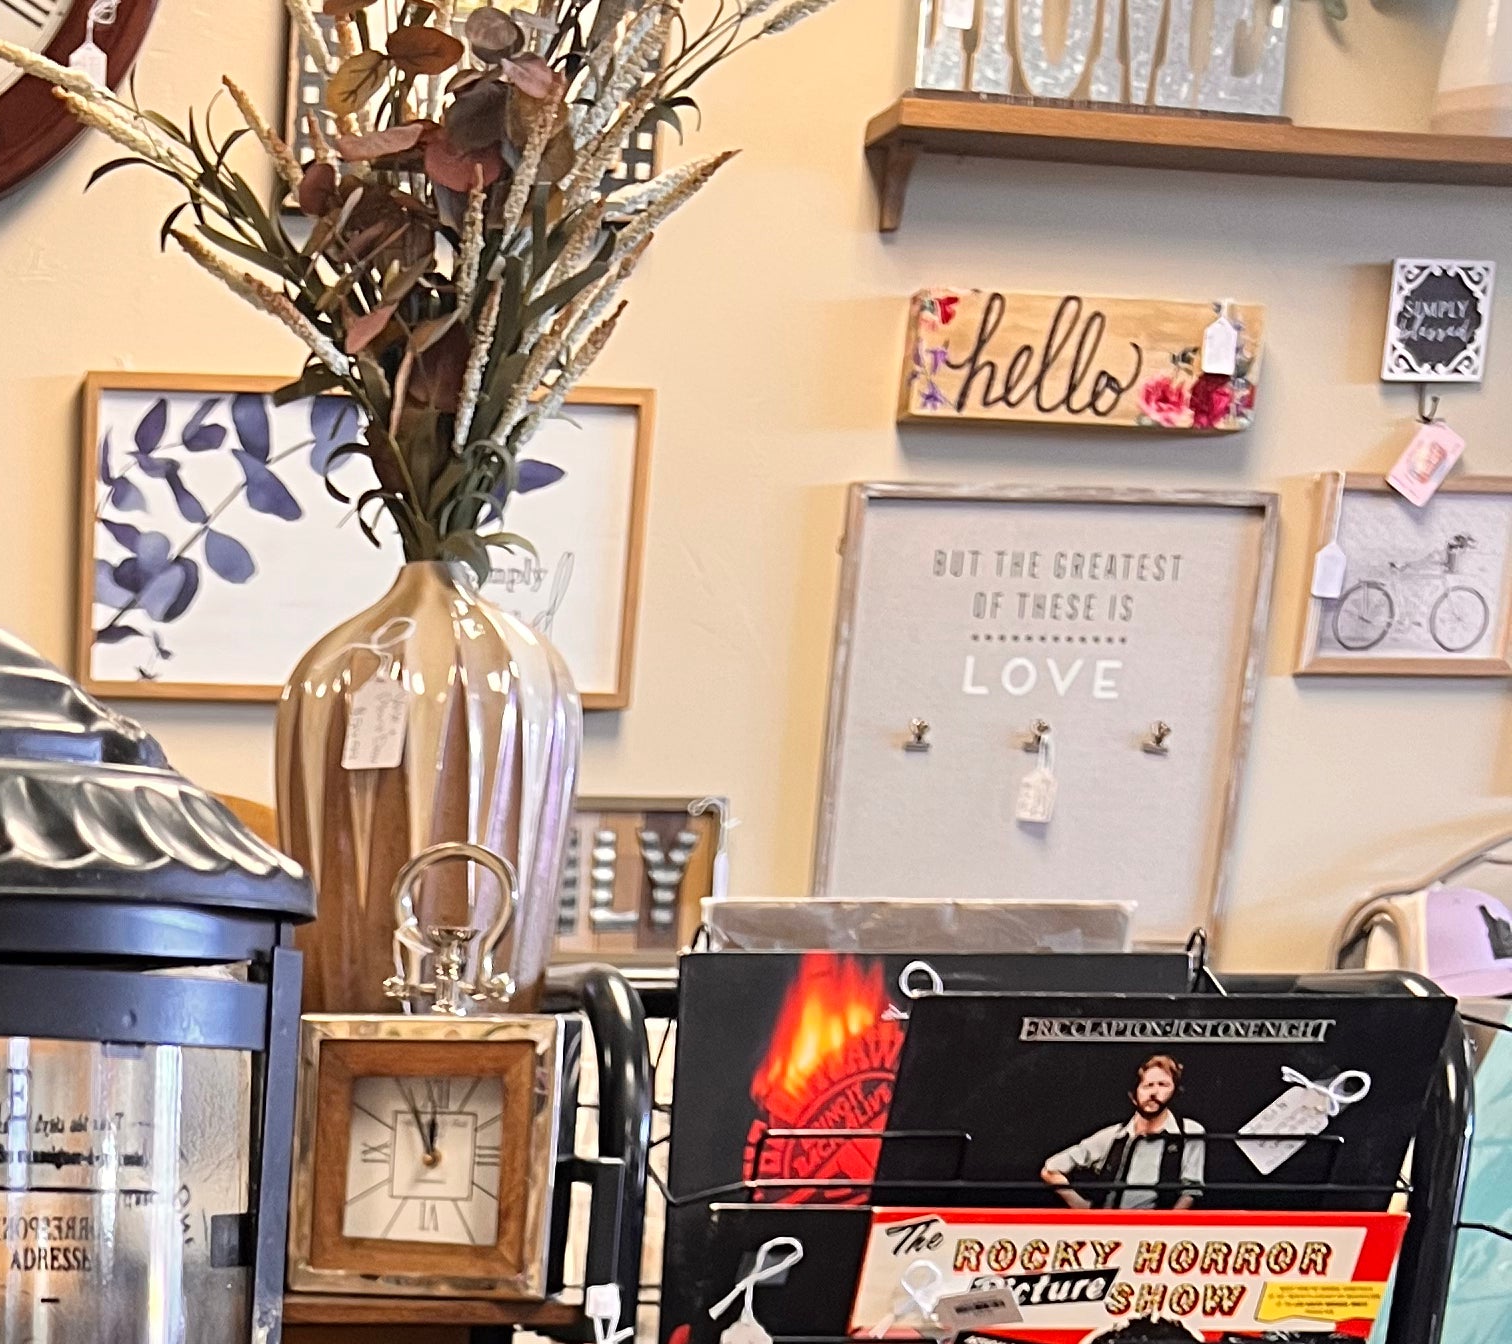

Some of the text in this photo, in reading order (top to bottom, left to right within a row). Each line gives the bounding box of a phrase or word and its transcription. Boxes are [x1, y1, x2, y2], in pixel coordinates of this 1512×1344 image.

[946, 291, 1143, 416] hello
[933, 549, 1185, 582] BUT THE GREATEST
[973, 591, 1134, 622] OF THESE IS
[962, 655, 1124, 700] LOVE
[886, 1217, 946, 1257] The
[952, 1239, 1334, 1276] ROCKY HORROR
[1104, 1282, 1247, 1316] SHOW
